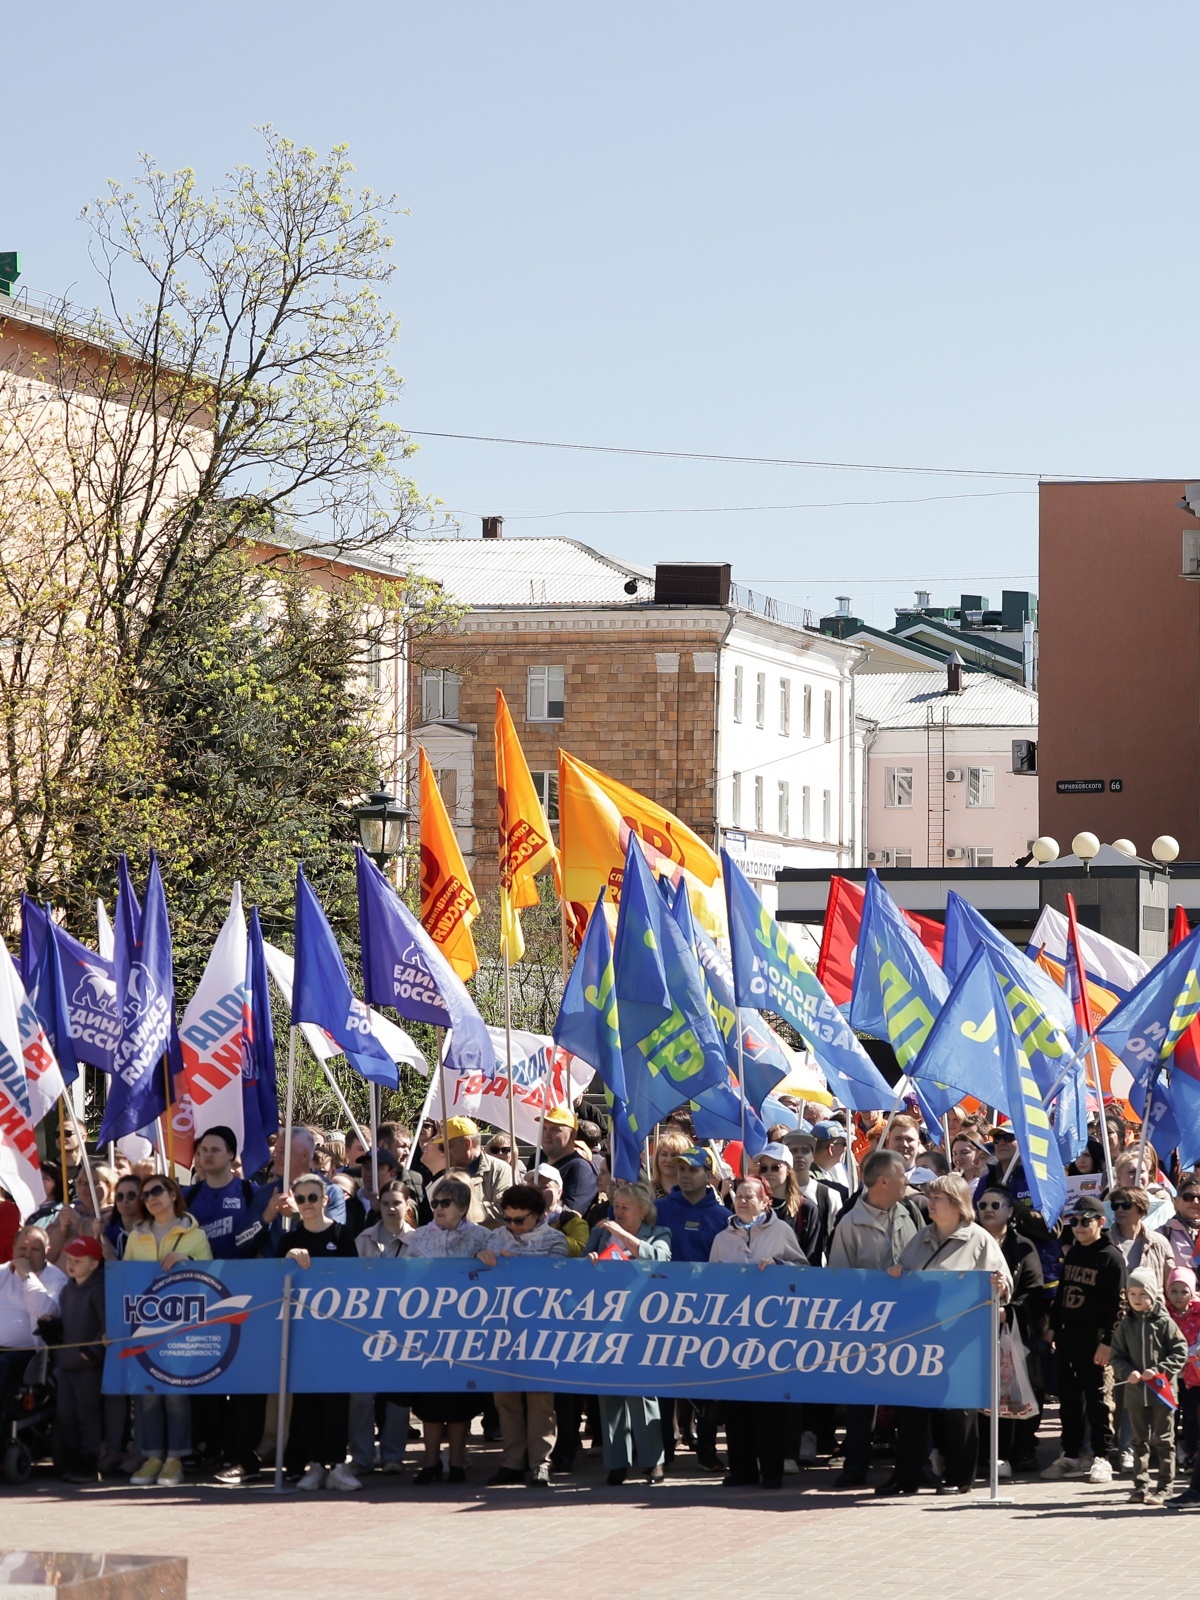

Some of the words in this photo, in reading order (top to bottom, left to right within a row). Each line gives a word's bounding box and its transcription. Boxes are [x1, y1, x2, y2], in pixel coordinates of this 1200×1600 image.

[1111, 781, 1121, 790] 66
[393, 981, 448, 1011] РОССИ
[752, 954, 849, 1023] МОЛОДЕ
[70, 1027, 119, 1053] ОССИ
[151, 1273, 193, 1292] НОВГОРОДСКАЯ
[194, 1273, 222, 1290] ОБЛАСТНАЯ
[123, 1294, 206, 1324] НОФП
[276, 1285, 632, 1326] НОВГОРОДСКАЯ
[638, 1289, 897, 1333] ОБЛАСТНАЯ
[159, 1349, 221, 1357] СПРАВЕДЛИВОСТЬ
[362, 1328, 634, 1370] ФЕДЕРАЦИЯ
[638, 1333, 946, 1377] ПРОФСОЮЗОВ
[149, 1367, 182, 1386] ФЕДЕРАЦИЯ
[182, 1366, 222, 1386] ПРОФСОЮЗОВ
